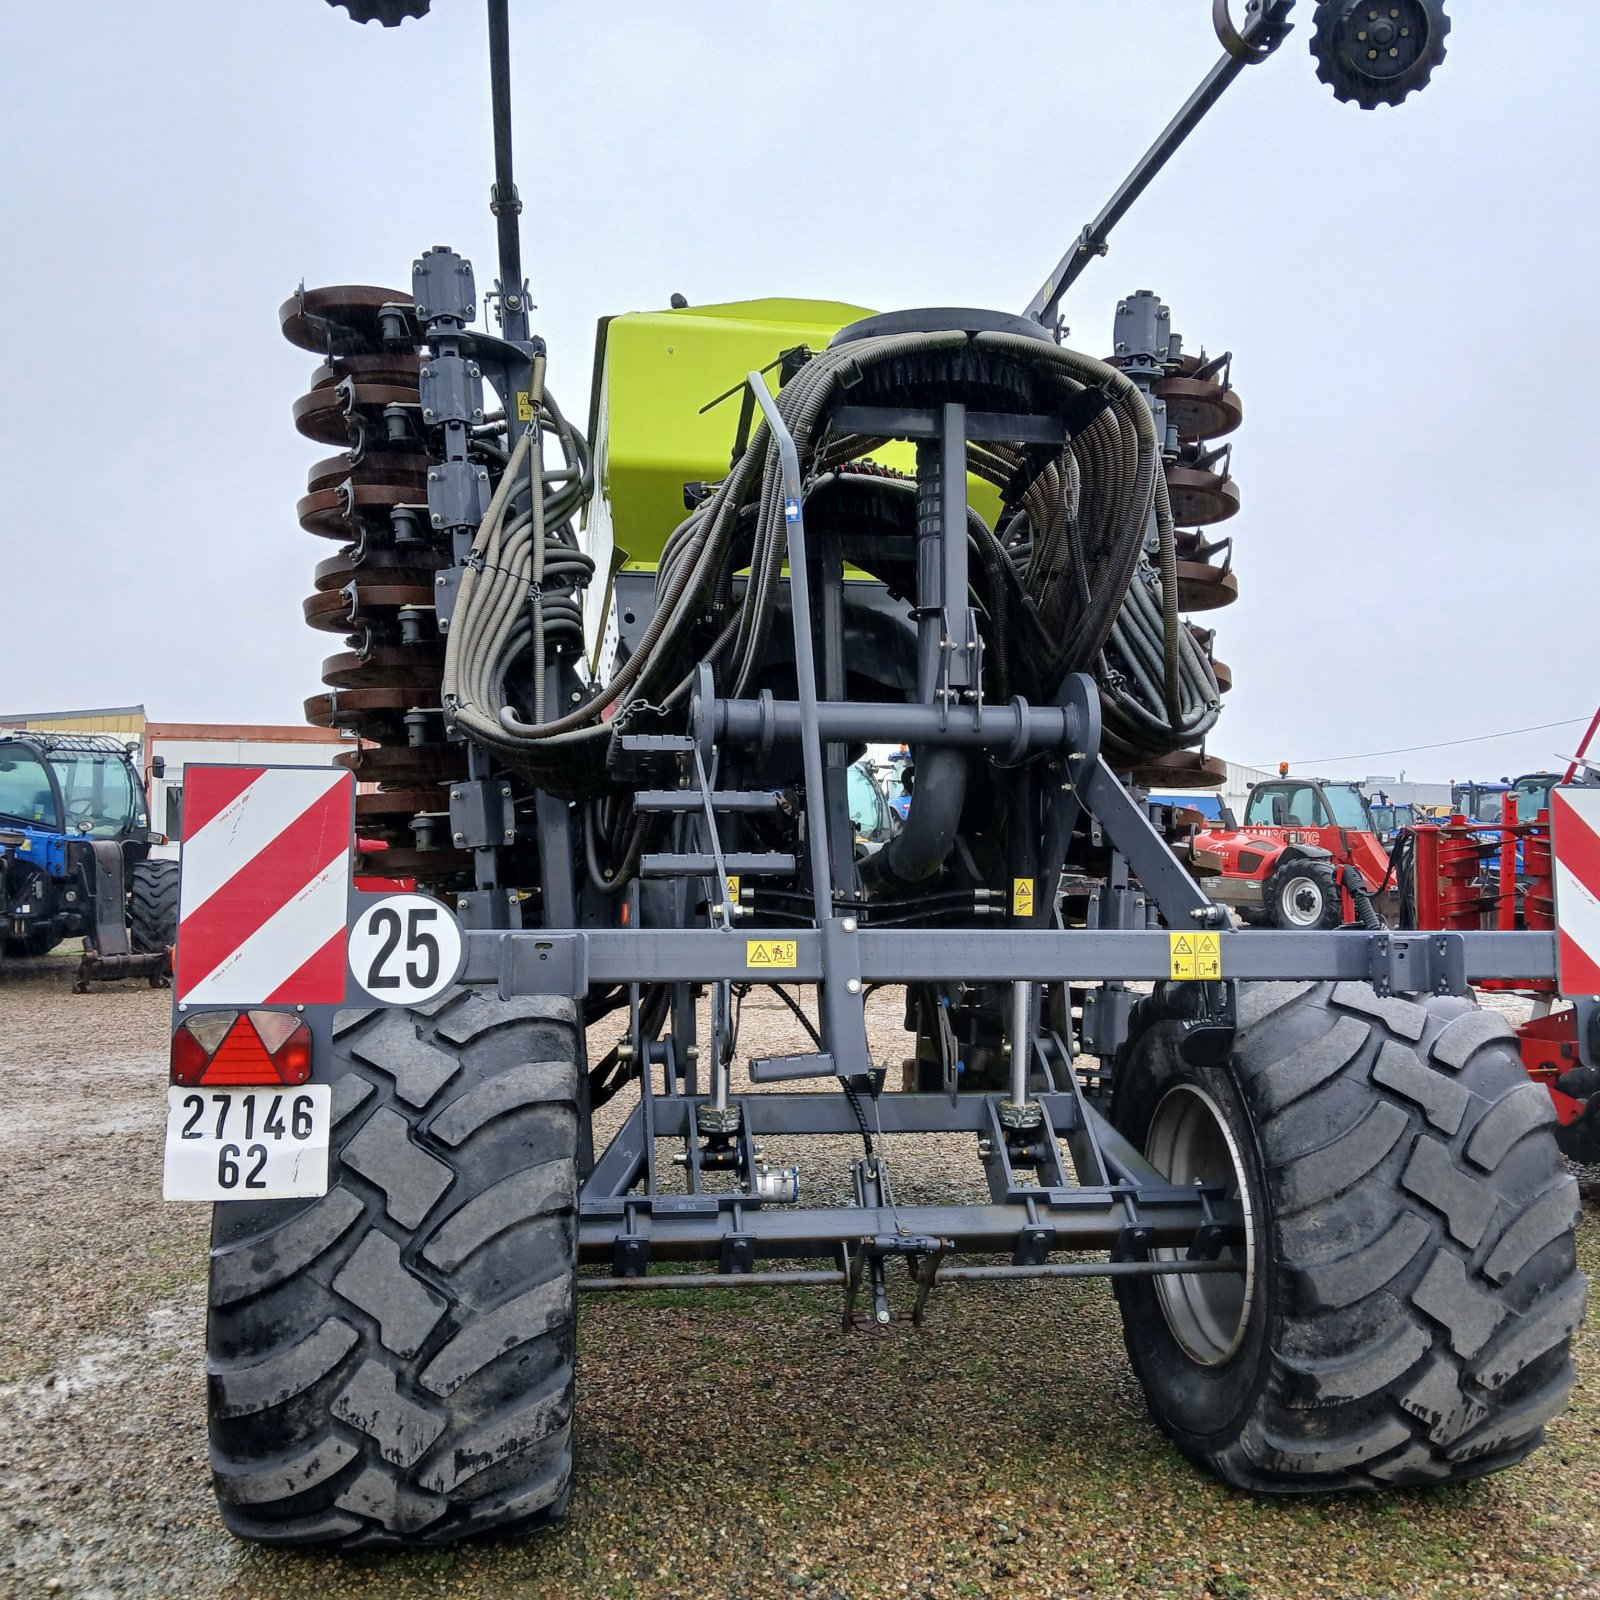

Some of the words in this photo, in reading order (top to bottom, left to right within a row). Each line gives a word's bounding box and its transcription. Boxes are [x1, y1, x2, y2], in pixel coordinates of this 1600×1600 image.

[367, 907, 440, 989] 25
[182, 1094, 314, 1140] 27146
[218, 1143, 268, 1189] 62
